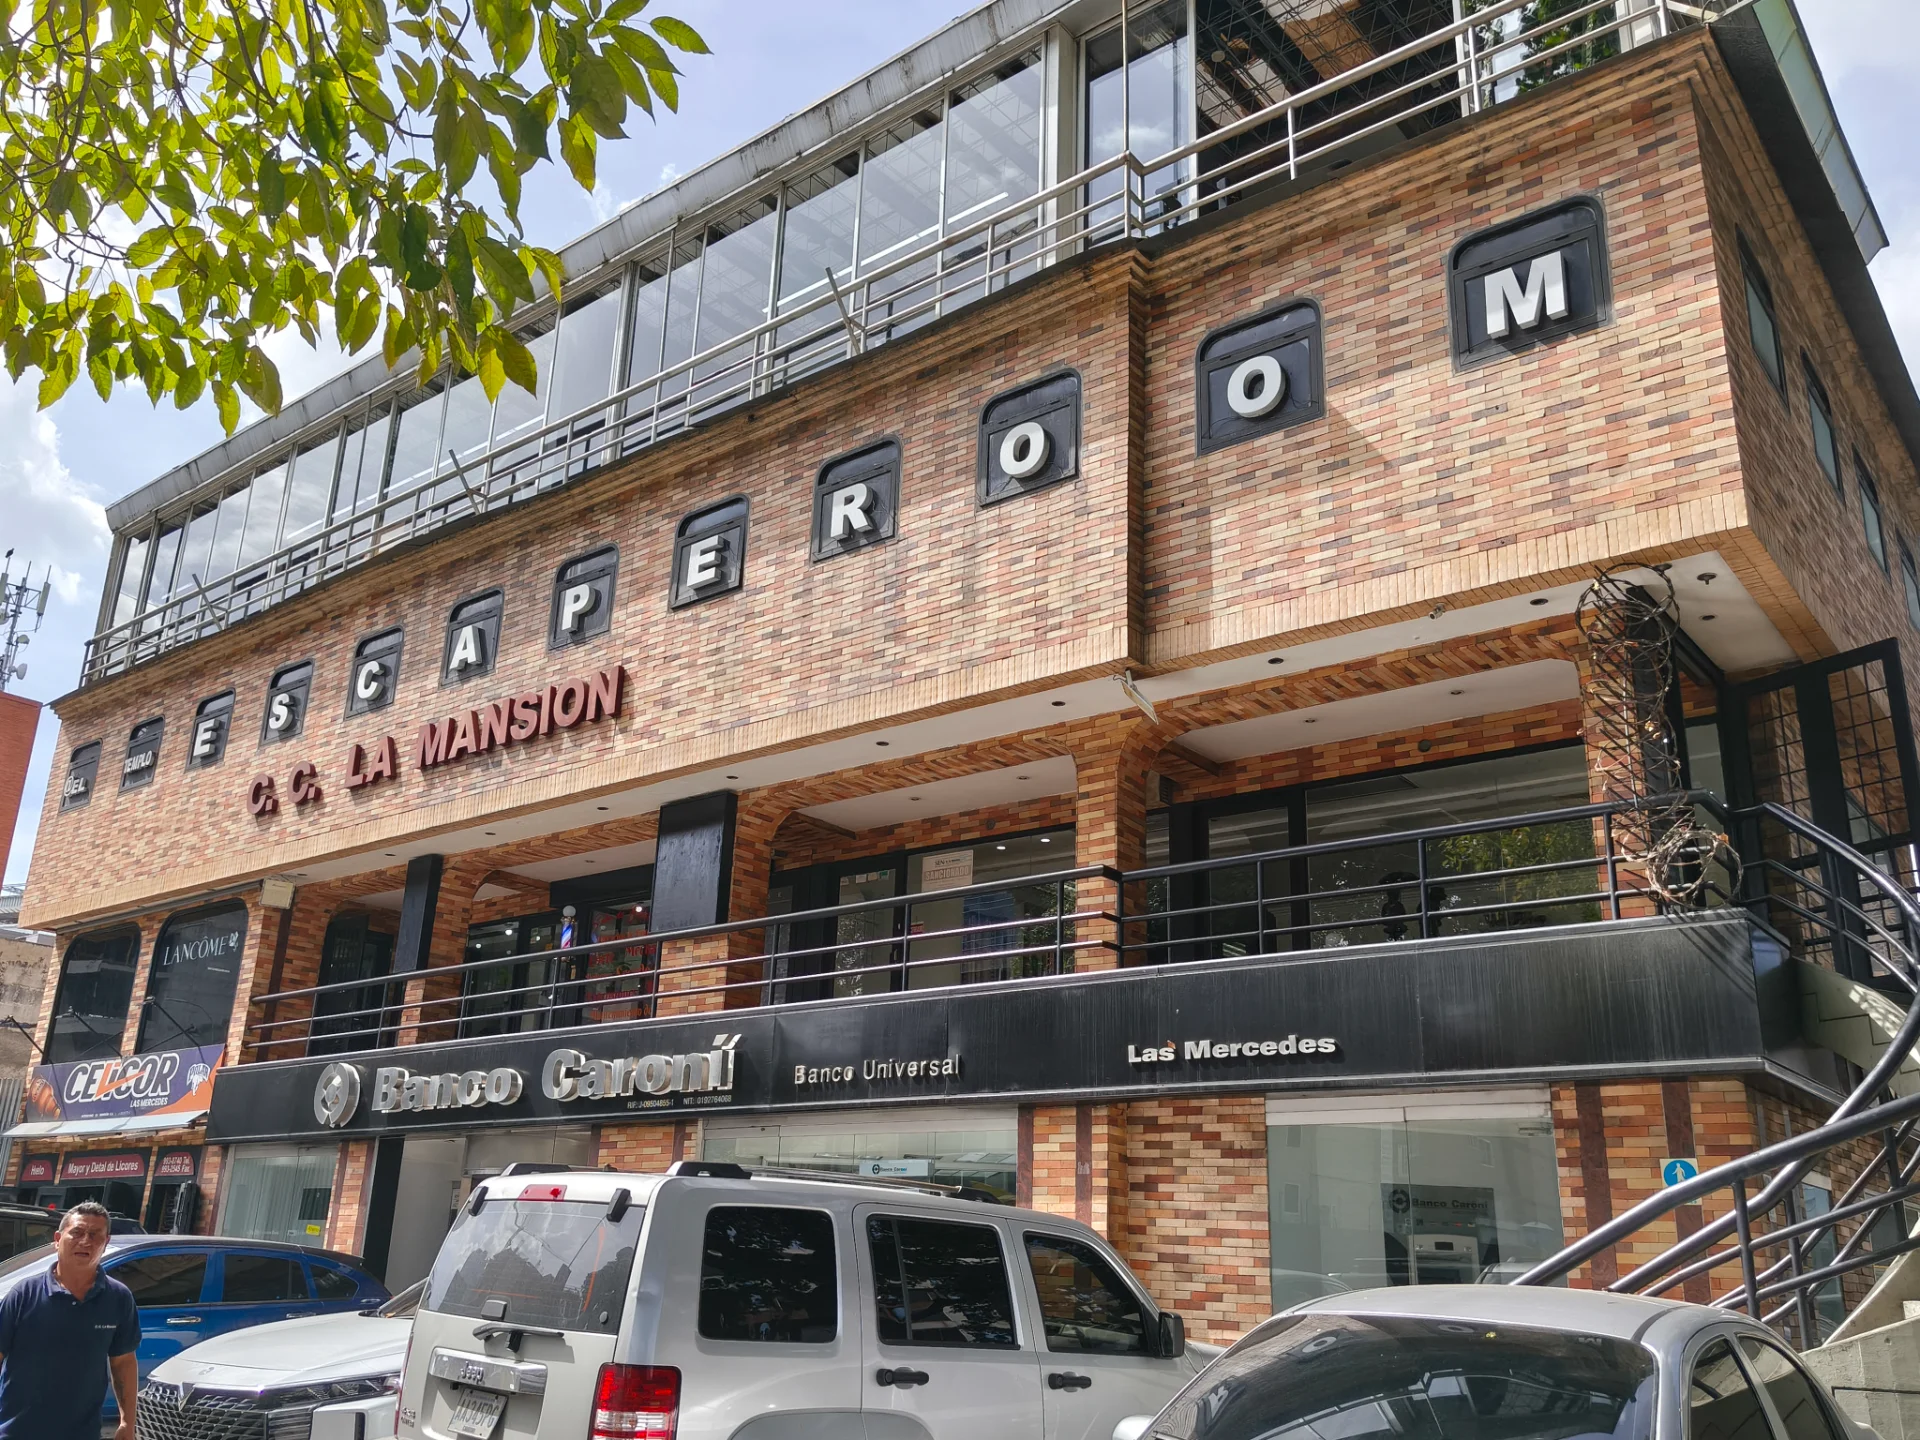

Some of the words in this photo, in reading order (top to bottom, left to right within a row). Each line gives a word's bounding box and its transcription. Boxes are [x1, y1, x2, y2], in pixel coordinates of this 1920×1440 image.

[345, 735, 396, 788] LA
[416, 666, 624, 769] MANSION
[124, 750, 154, 773] TEMPLO
[925, 866, 969, 880] SANCIONADO
[163, 936, 229, 966] LANCÔME
[1128, 1044, 1175, 1062] Las
[1184, 1034, 1336, 1060] Mercedes
[371, 1067, 524, 1113] Banco
[541, 1034, 744, 1102] Caroní
[795, 1065, 854, 1084] Banco
[863, 1054, 960, 1079] Universal
[130, 1100, 140, 1108] LAS
[141, 1097, 169, 1107] MERCEDES
[30, 1165, 45, 1175] Hielo
[67, 1163, 84, 1175] Mayor
[91, 1162, 107, 1172] Detal
[107, 1163, 115, 1171] de
[115, 1160, 139, 1171] Licores
[460, 1361, 485, 1384] Jeep
